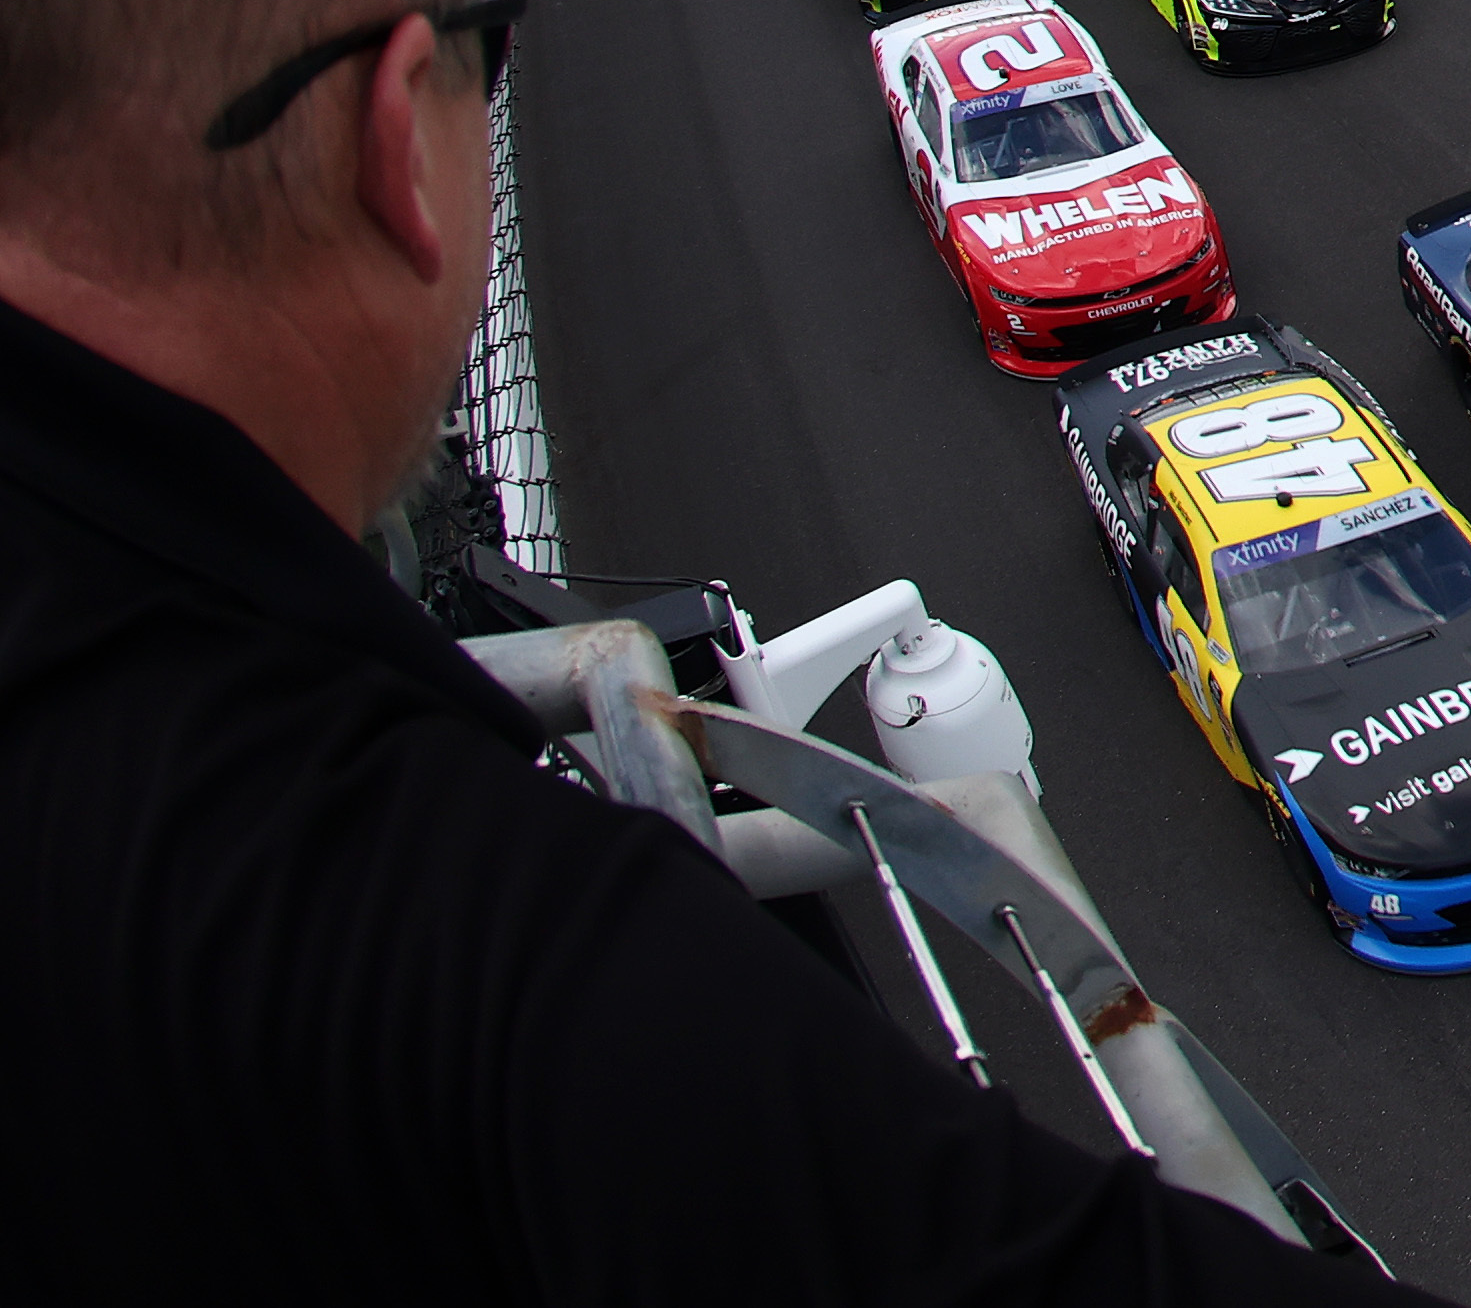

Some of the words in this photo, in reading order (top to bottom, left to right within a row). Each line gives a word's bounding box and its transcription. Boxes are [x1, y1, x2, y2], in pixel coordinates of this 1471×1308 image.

[1212, 18, 1229, 31] 20
[959, 21, 1065, 91] 2
[961, 93, 1011, 118] xfinity
[1050, 79, 1083, 96] LOVE
[961, 166, 1198, 251] WHELEN
[993, 221, 1114, 265] MANUFACTURED
[1118, 217, 1133, 230] IN
[1136, 208, 1204, 228] AMERICA
[1405, 246, 1443, 306] Road
[1007, 313, 1025, 332] 2
[1087, 295, 1154, 321] CHEVROLET
[1168, 392, 1379, 503] 48
[1067, 427, 1137, 570] GAINBRIDGE
[1227, 531, 1299, 567] xfinity
[1340, 496, 1417, 534] SANCHEZ
[1375, 778, 1428, 817] visit
[1370, 893, 1400, 916] 48
